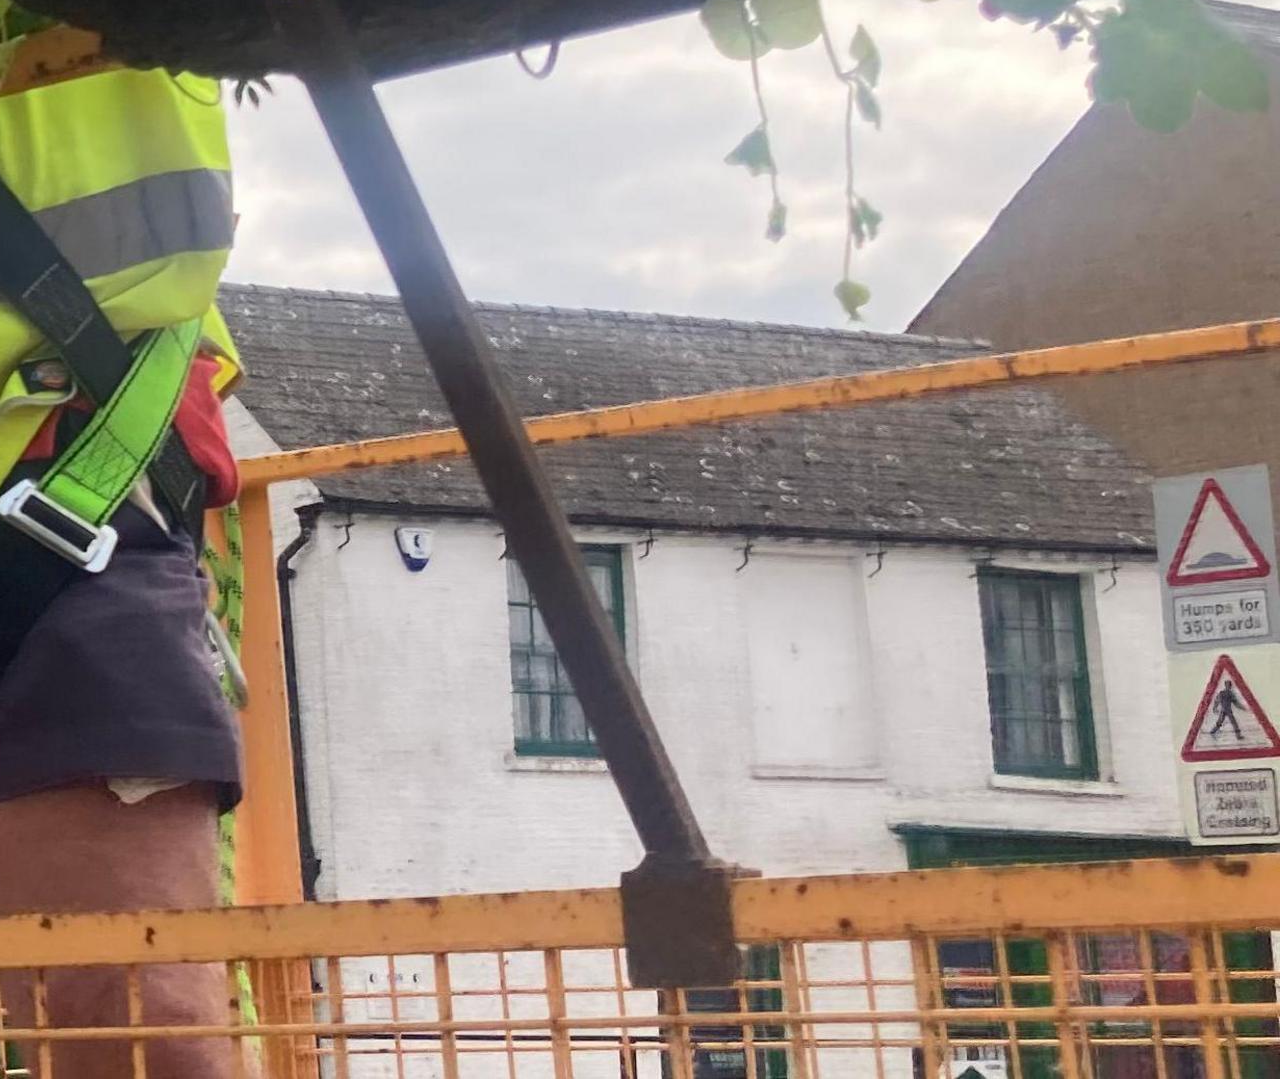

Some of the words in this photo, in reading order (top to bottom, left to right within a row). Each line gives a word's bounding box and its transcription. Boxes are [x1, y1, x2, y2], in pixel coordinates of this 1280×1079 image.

[1181, 603, 1233, 617] Humps
[1240, 599, 1259, 612] for
[1182, 619, 1214, 635] 350
[1220, 616, 1262, 633] yards
